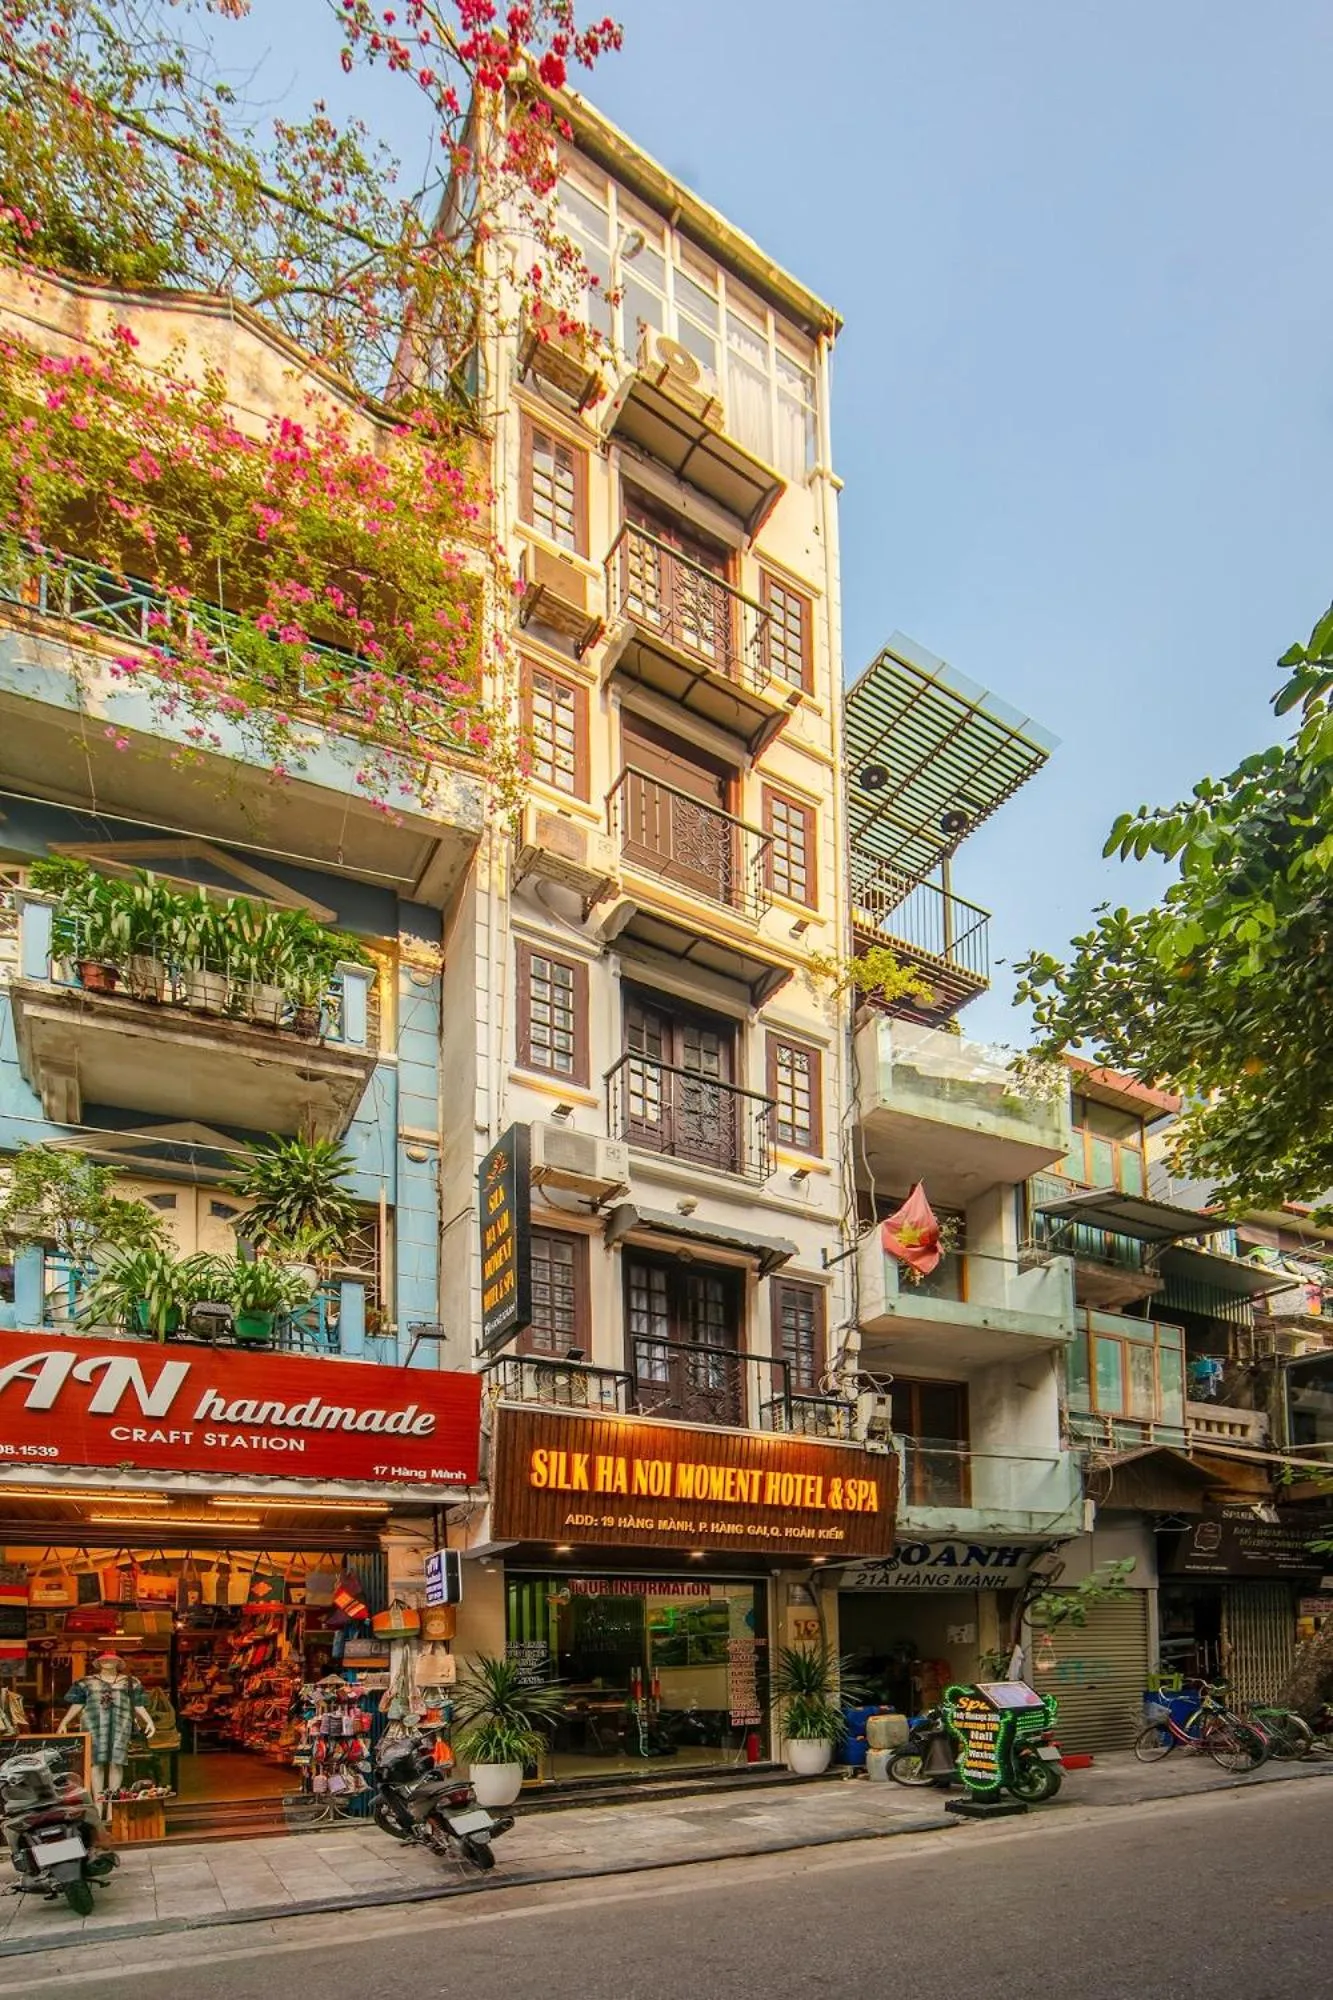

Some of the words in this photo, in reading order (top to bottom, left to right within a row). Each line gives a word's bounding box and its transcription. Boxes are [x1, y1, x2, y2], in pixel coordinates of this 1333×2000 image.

[193, 1389, 436, 1435] handmade
[110, 1426, 193, 1445] CRAFT
[204, 1433, 305, 1452] STATION
[373, 1465, 388, 1475] 17
[391, 1466, 427, 1479] Hàng
[530, 1449, 590, 1491] SILK
[594, 1455, 628, 1494] HA
[631, 1459, 672, 1497] NOI
[675, 1462, 763, 1504] MOMENT
[763, 1471, 826, 1509] HOTEL
[565, 1514, 598, 1526] ADD:
[601, 1515, 615, 1527] 19
[618, 1514, 654, 1529] HÀNG
[699, 1522, 708, 1533] P.
[711, 1521, 744, 1534] HÀNG
[784, 1526, 815, 1538] HOÀN
[895, 1570, 950, 1586] HÀNG
[613, 1581, 711, 1597] INFORMATION
[793, 1619, 819, 1640] 19
[970, 1730, 993, 1741] Nail
